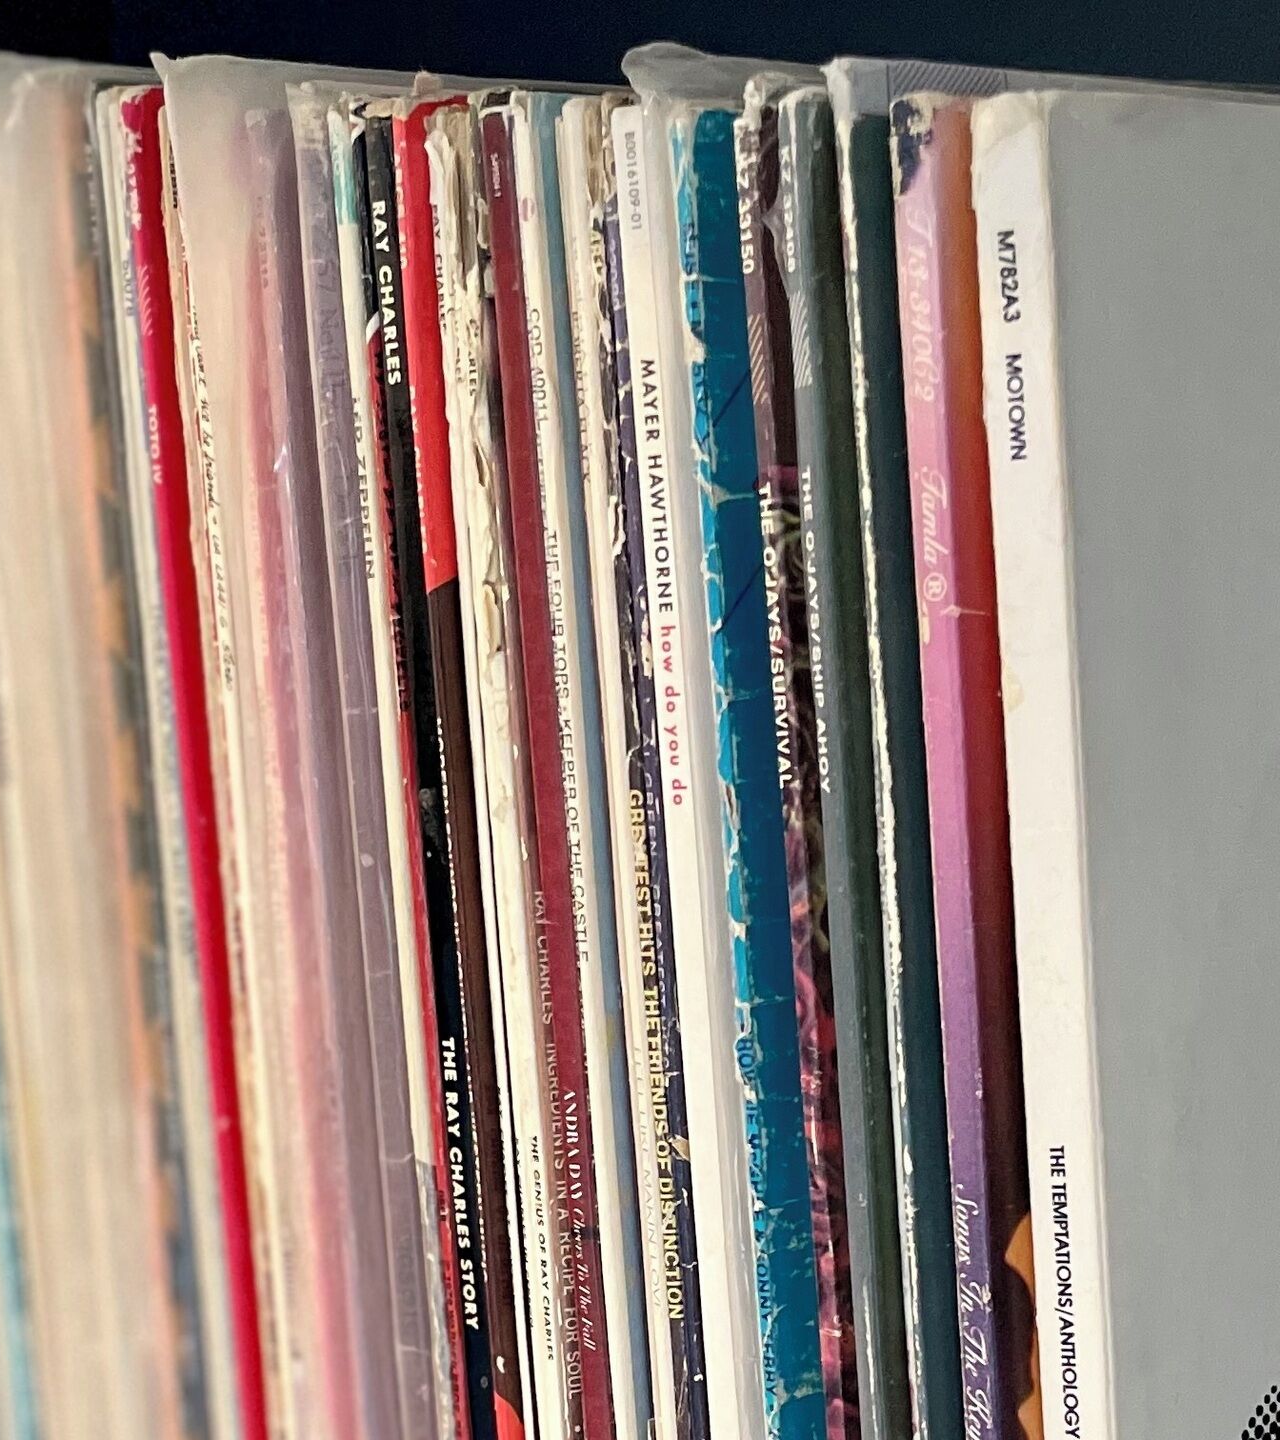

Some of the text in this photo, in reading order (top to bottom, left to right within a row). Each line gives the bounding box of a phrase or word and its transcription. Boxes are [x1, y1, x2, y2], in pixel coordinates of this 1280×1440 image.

[779, 145, 792, 187] KZ
[738, 197, 755, 274] 33150
[370, 199, 402, 386] RAY CHARLES
[996, 230, 1028, 461] M782A3 MOTOWN
[146, 404, 161, 459] TOTO
[356, 454, 376, 580] ZEPPELIN
[918, 464, 950, 563] Tamla
[544, 531, 560, 570] THE
[640, 359, 689, 806] MAYER HAWTHORNE how do you do
[548, 579, 565, 637] FOUR
[758, 481, 793, 789] THE O'JAYS/SURVIVAL
[801, 466, 830, 794] THE O'JAYS/SHIP AHOY
[553, 643, 570, 699] TOPS
[558, 719, 577, 800] KEEPER
[643, 772, 658, 855] GREEN
[568, 839, 583, 877] THE
[571, 884, 590, 963] CASTLE
[637, 922, 657, 976] HITS
[650, 884, 668, 1008] GREATEST
[535, 934, 554, 1025] CHARLES
[644, 985, 661, 1030] THE
[543, 1041, 564, 1170] INGREDIENTS
[647, 1035, 669, 1132] FRIENDS
[561, 1087, 580, 1156] ANDRA
[655, 1138, 671, 1168] OF
[440, 1037, 479, 1330] THE RAY CHARLES STORY
[567, 1163, 584, 1201] DAY
[1048, 1144, 1066, 1176] THE
[657, 1177, 684, 1319] DISTINCTION
[952, 1184, 981, 1264] Songs
[532, 1169, 544, 1227] GENIUS
[542, 1294, 554, 1360] CHARLES
[558, 1231, 574, 1294] RECIPE
[754, 1250, 772, 1321] ONNY
[958, 1272, 986, 1310] In
[563, 1306, 578, 1344] FOR
[579, 1285, 593, 1313] The
[581, 1316, 596, 1351] Fall
[1048, 1184, 1081, 1438] TEMPTATIONS/ANTHOLOGY
[565, 1350, 582, 1399] SOUL
[759, 1328, 777, 1396] ERRY
[961, 1320, 989, 1375] The
